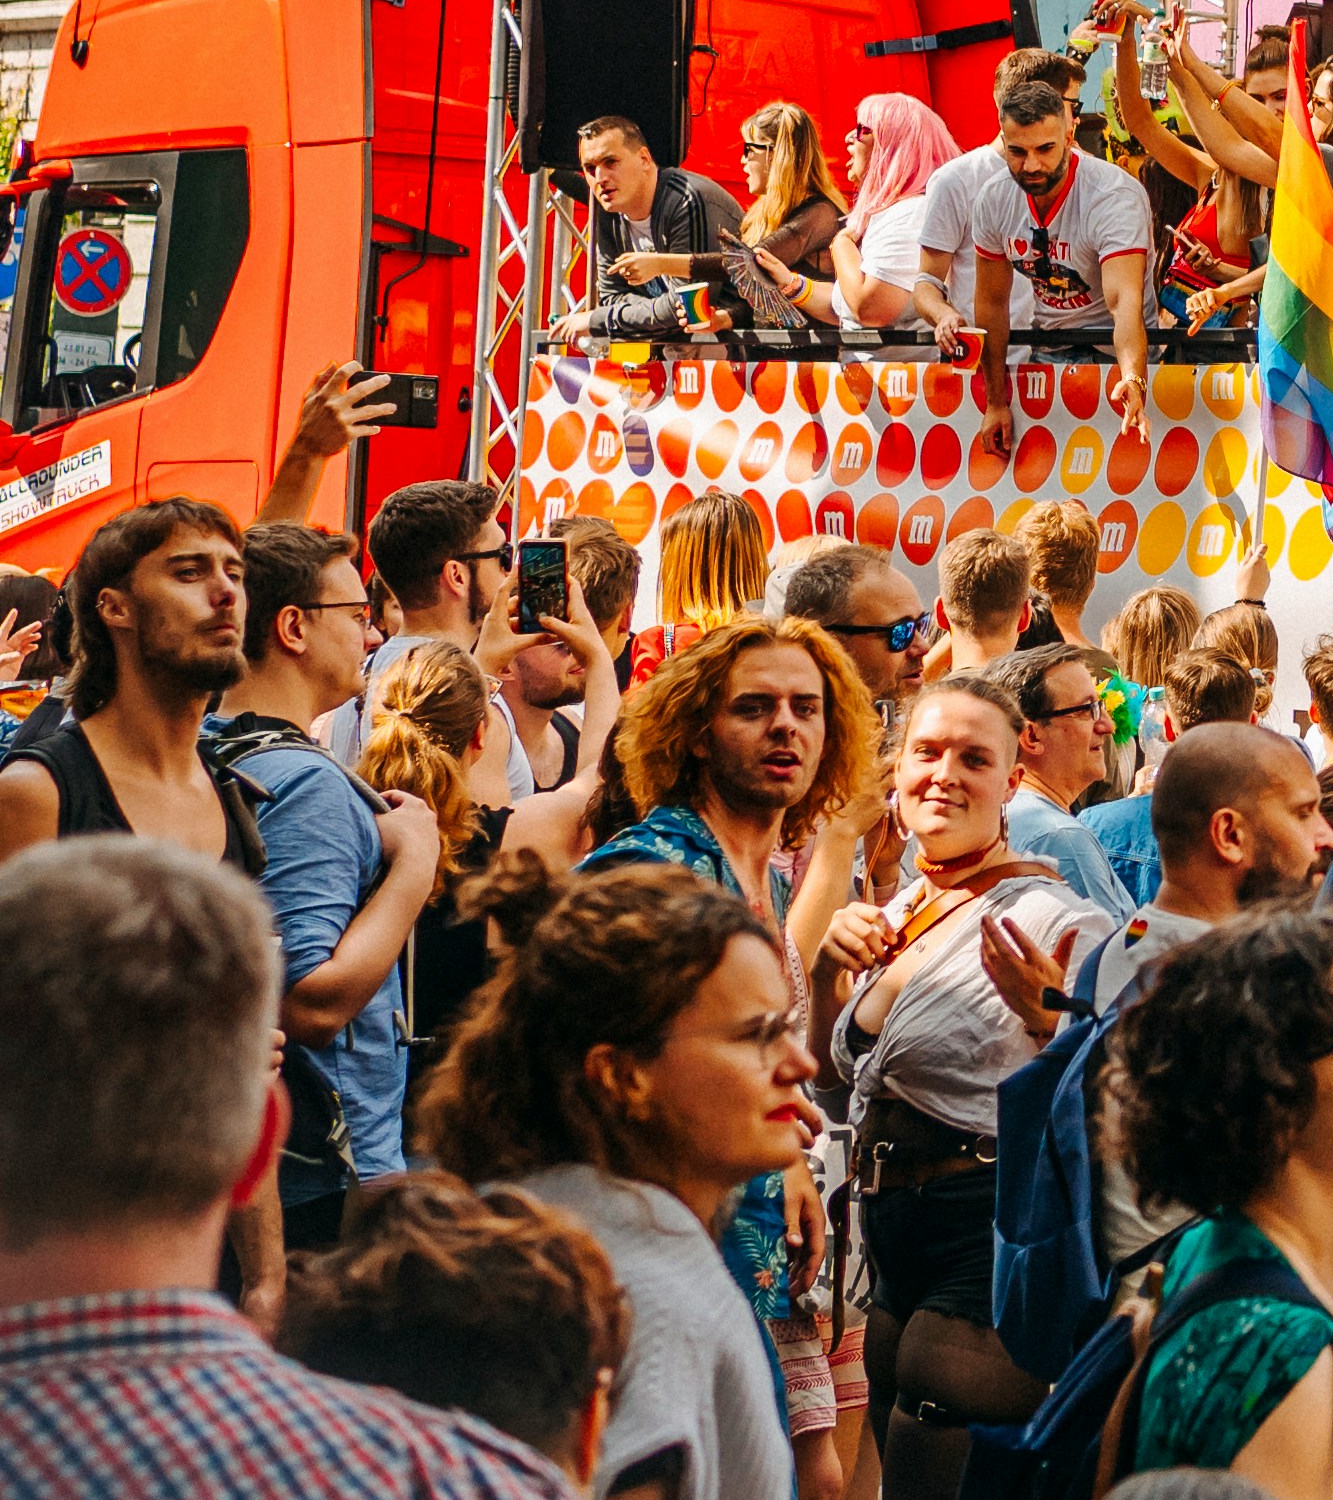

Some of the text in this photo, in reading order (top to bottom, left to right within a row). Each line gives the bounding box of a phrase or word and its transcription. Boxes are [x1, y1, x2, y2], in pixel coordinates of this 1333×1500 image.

[680, 367, 698, 393] m
[887, 370, 908, 397] m
[1027, 372, 1046, 399] m
[1212, 371, 1234, 400] m
[594, 430, 615, 457] m
[747, 439, 772, 464] m
[839, 442, 863, 468] m
[1069, 447, 1094, 474] m
[909, 515, 934, 543] m
[1099, 522, 1126, 552] m
[1197, 525, 1225, 557] m
